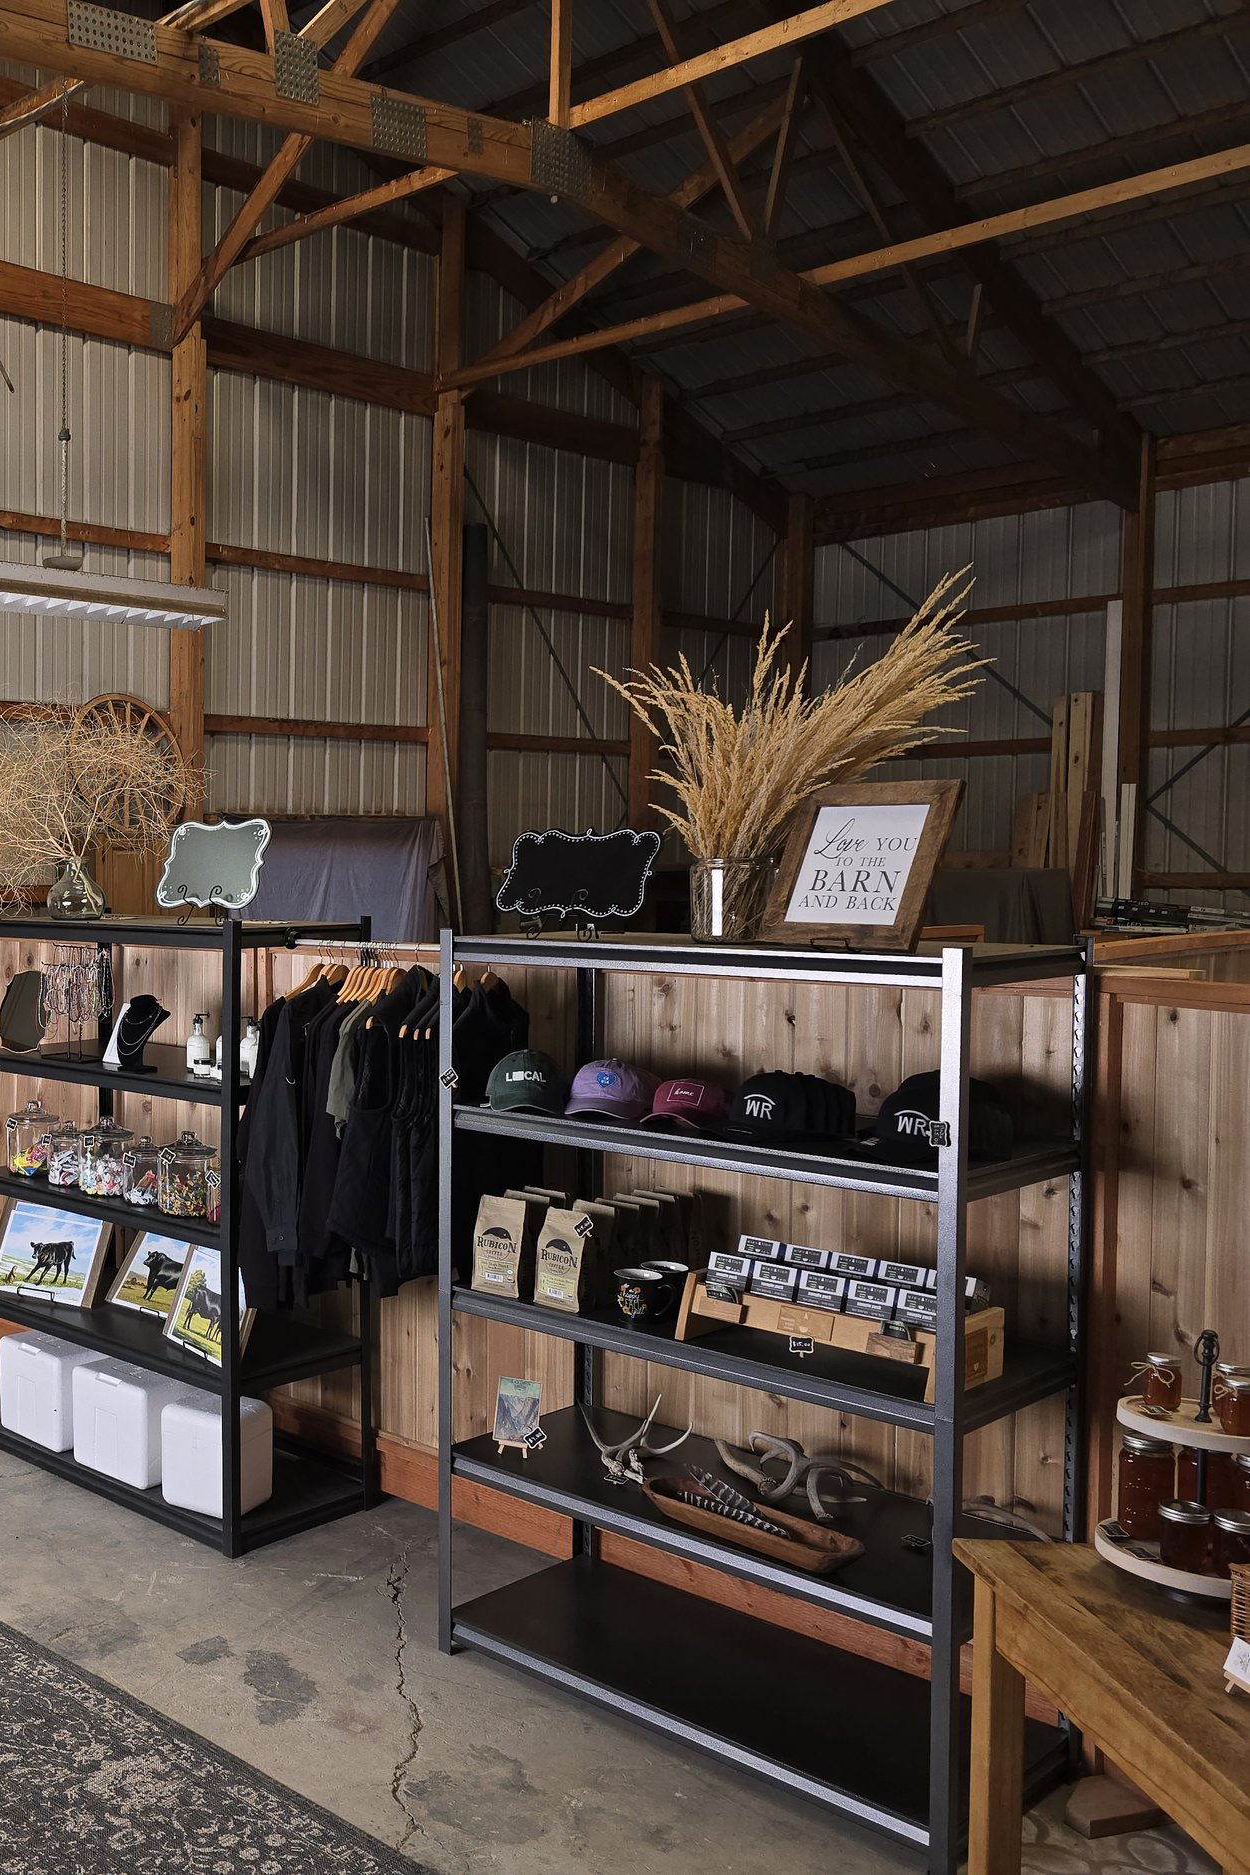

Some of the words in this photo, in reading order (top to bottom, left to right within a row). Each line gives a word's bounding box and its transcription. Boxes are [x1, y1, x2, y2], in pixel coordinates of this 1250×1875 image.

[814, 818, 869, 859] Love
[876, 837, 917, 851] YOU
[835, 857, 853, 867] TO
[860, 857, 886, 867] THE
[809, 869, 902, 894] BARN
[798, 895, 837, 909] AND
[846, 896, 898, 911] BACK
[745, 1099, 772, 1120] WR
[897, 1116, 927, 1137] WR
[477, 1236, 517, 1253] RUBICON
[541, 1249, 578, 1268] RUBICON
